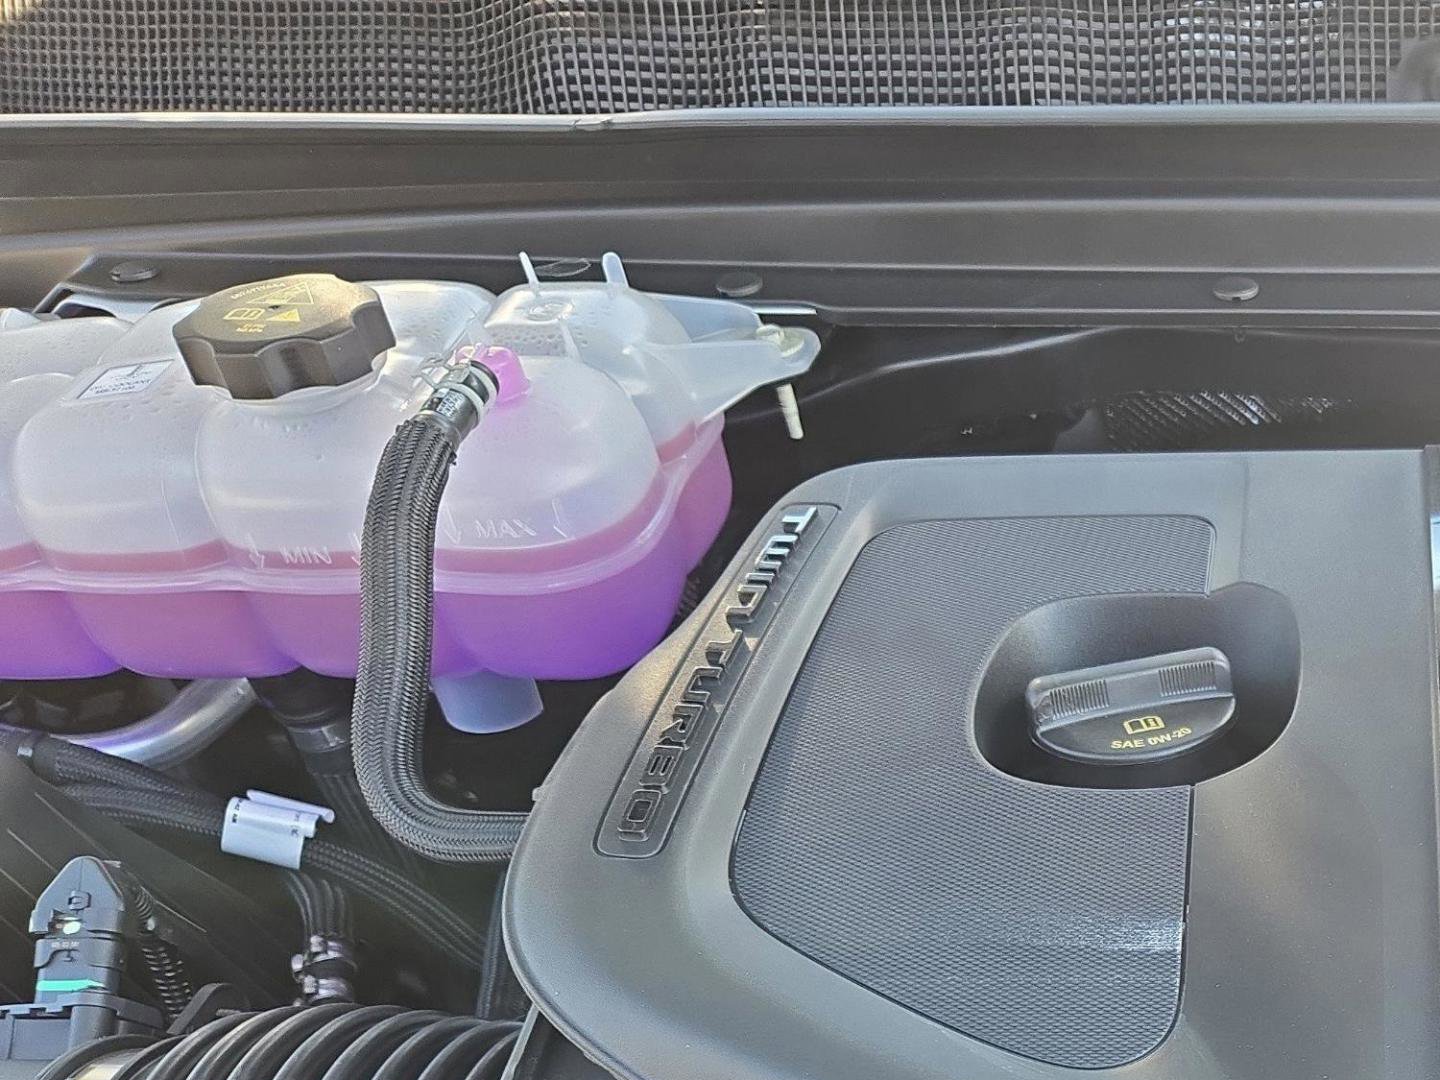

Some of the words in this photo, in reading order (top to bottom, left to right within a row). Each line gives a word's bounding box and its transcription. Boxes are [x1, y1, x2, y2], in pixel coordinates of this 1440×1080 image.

[472, 518, 538, 539] MAX
[279, 546, 333, 565] MIN
[725, 506, 818, 630] TWIN
[617, 629, 743, 842] TURBO
[1110, 739, 1146, 749] SAE
[1147, 727, 1192, 746] 0W-20
